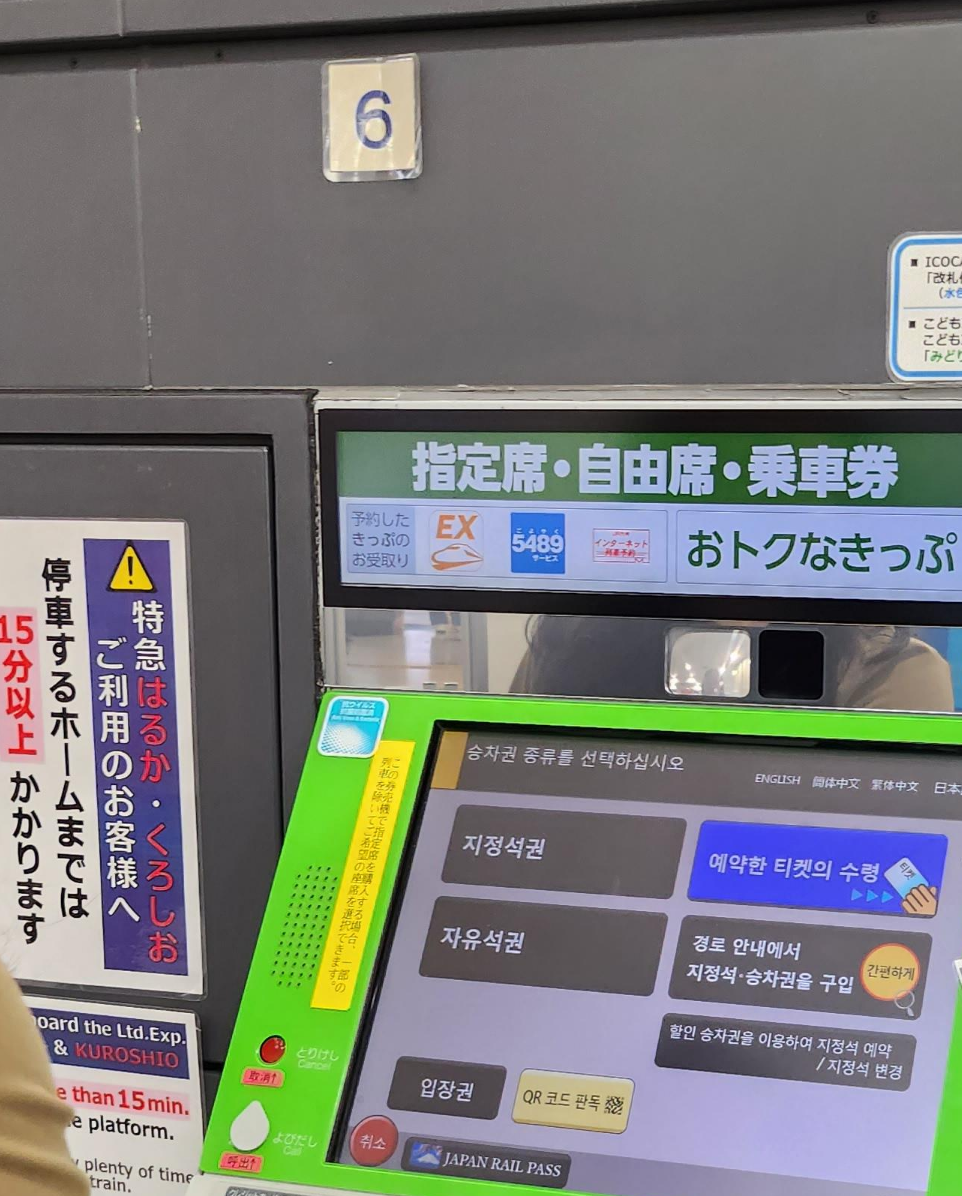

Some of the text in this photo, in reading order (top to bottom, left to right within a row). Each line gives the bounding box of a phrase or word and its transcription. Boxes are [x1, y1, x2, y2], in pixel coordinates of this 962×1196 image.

[355, 90, 393, 149] 6
[411, 441, 899, 499] 指定席・自由席・乗車券
[351, 510, 411, 529] 予約した
[435, 514, 478, 540] EX
[352, 531, 410, 547] きっぷの
[511, 533, 564, 554] 5489
[687, 529, 958, 574] おトクなきっぷ
[352, 551, 410, 569] お受取り
[41, 557, 90, 919] 停車するホームまでは
[467, 743, 685, 772] 승차권 종류를 선택하십시오
[96, 635, 141, 923] ご利用のお客様へ
[132, 599, 180, 964] 特急はるか・くろしお
[755, 773, 801, 786] ENGLISH
[462, 834, 546, 861] 지정석권
[709, 852, 881, 884] 예약한 티켓의 수령
[440, 926, 526, 955] 자유석권
[692, 935, 802, 961] 경로 안내에서
[819, 973, 855, 995] 구입
[866, 963, 916, 982] 간편하게
[83, 1019, 112, 1038] the
[669, 1023, 893, 1059] 할인 승차권을 이용하여 지정석 예약
[74, 1042, 180, 1069] KUROSHIO
[874, 1063, 904, 1081] 변경
[72, 1086, 115, 1107] than
[118, 1089, 145, 1112] 15
[148, 1096, 190, 1116] min.
[419, 1077, 475, 1103] 입장권
[522, 1089, 601, 1111] QR 코드 판독
[89, 1115, 175, 1141] platform.
[360, 1133, 387, 1151] 취소
[84, 1157, 133, 1180] plenty
[138, 1165, 154, 1180] of
[442, 1152, 562, 1178] JAPAN RAIL PASS
[89, 1175, 132, 1194] train.
